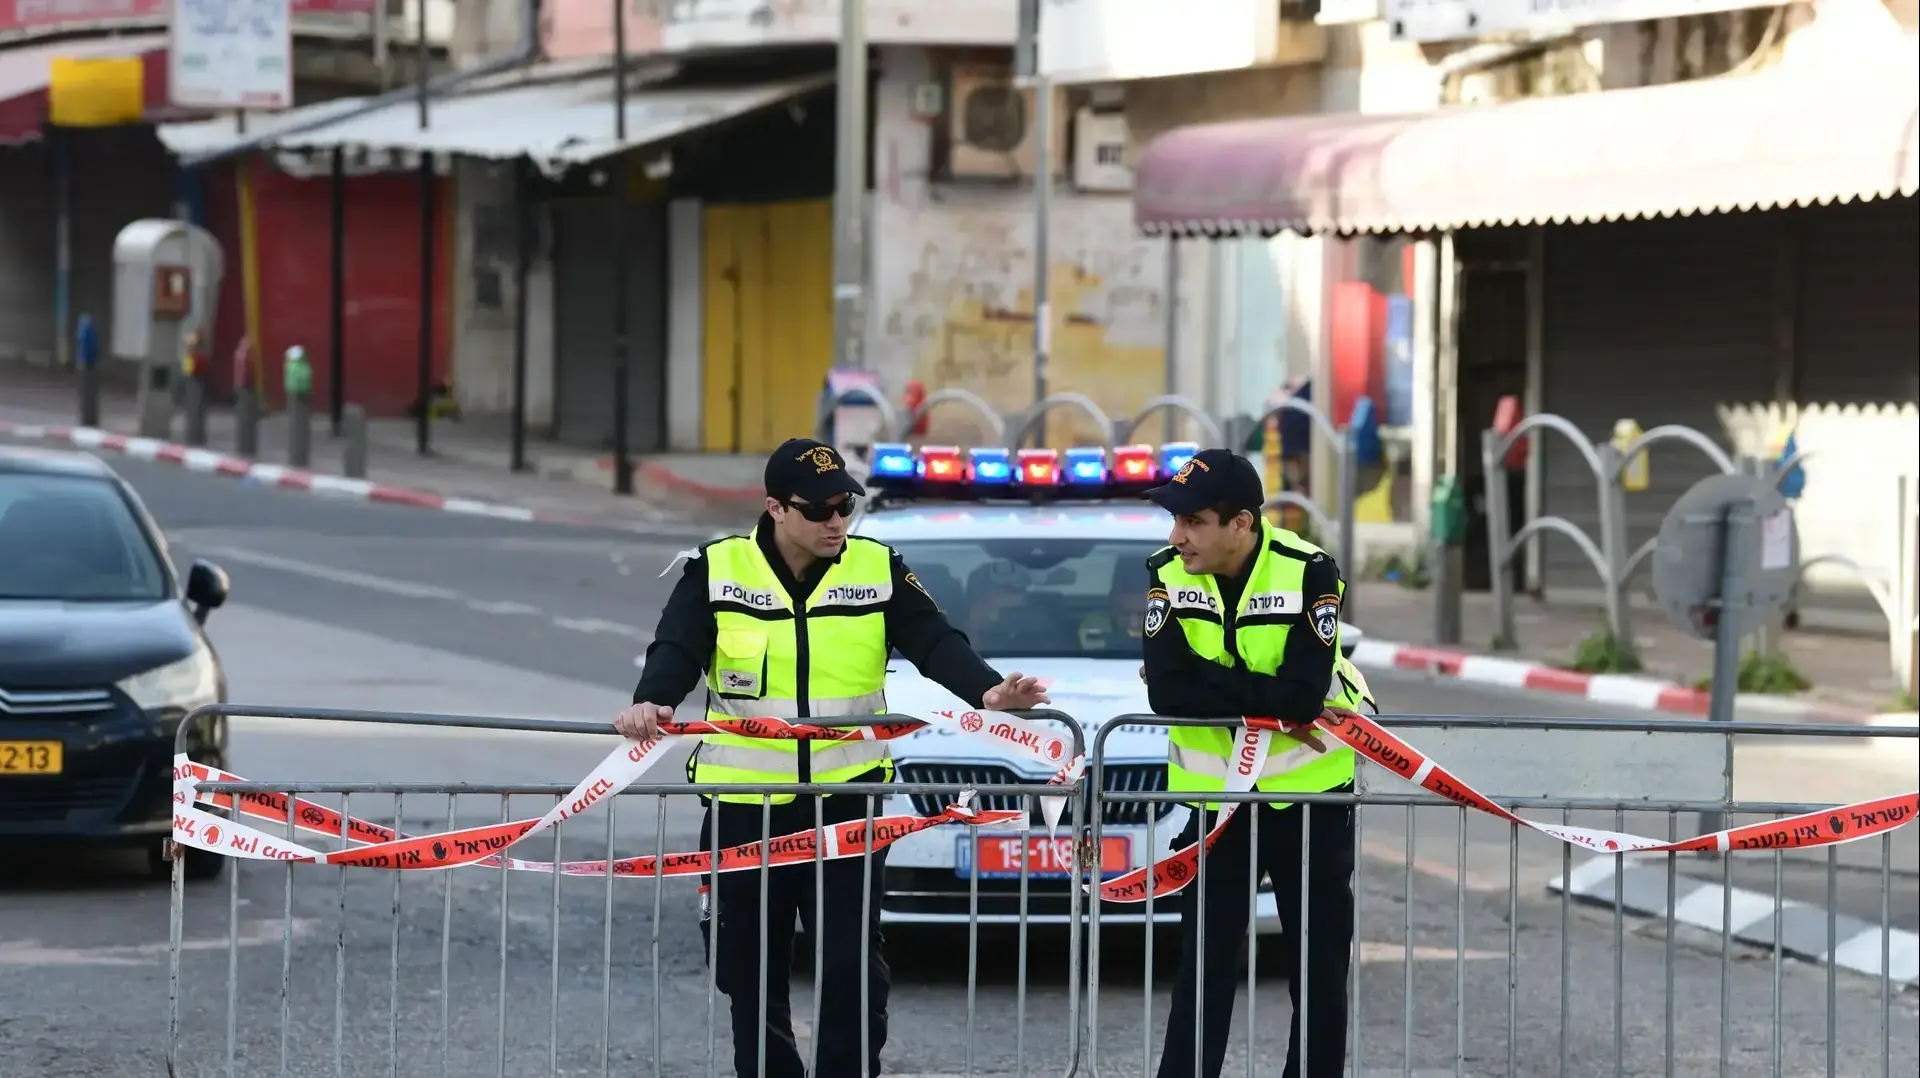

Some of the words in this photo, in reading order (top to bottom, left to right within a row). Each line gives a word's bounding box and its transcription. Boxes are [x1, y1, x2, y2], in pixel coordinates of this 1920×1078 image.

[722, 584, 773, 606] POLICE
[828, 587, 878, 600] משטרה
[988, 723, 1040, 753] ישראל
[1346, 723, 1411, 772] משטרת
[0, 746, 50, 770] 2-13
[571, 778, 614, 815] מעבר
[1850, 805, 1911, 829] ישראל
[230, 834, 259, 854] אין
[454, 833, 513, 856] ישראל
[1793, 824, 1820, 846] אין
[395, 849, 422, 868] אין
